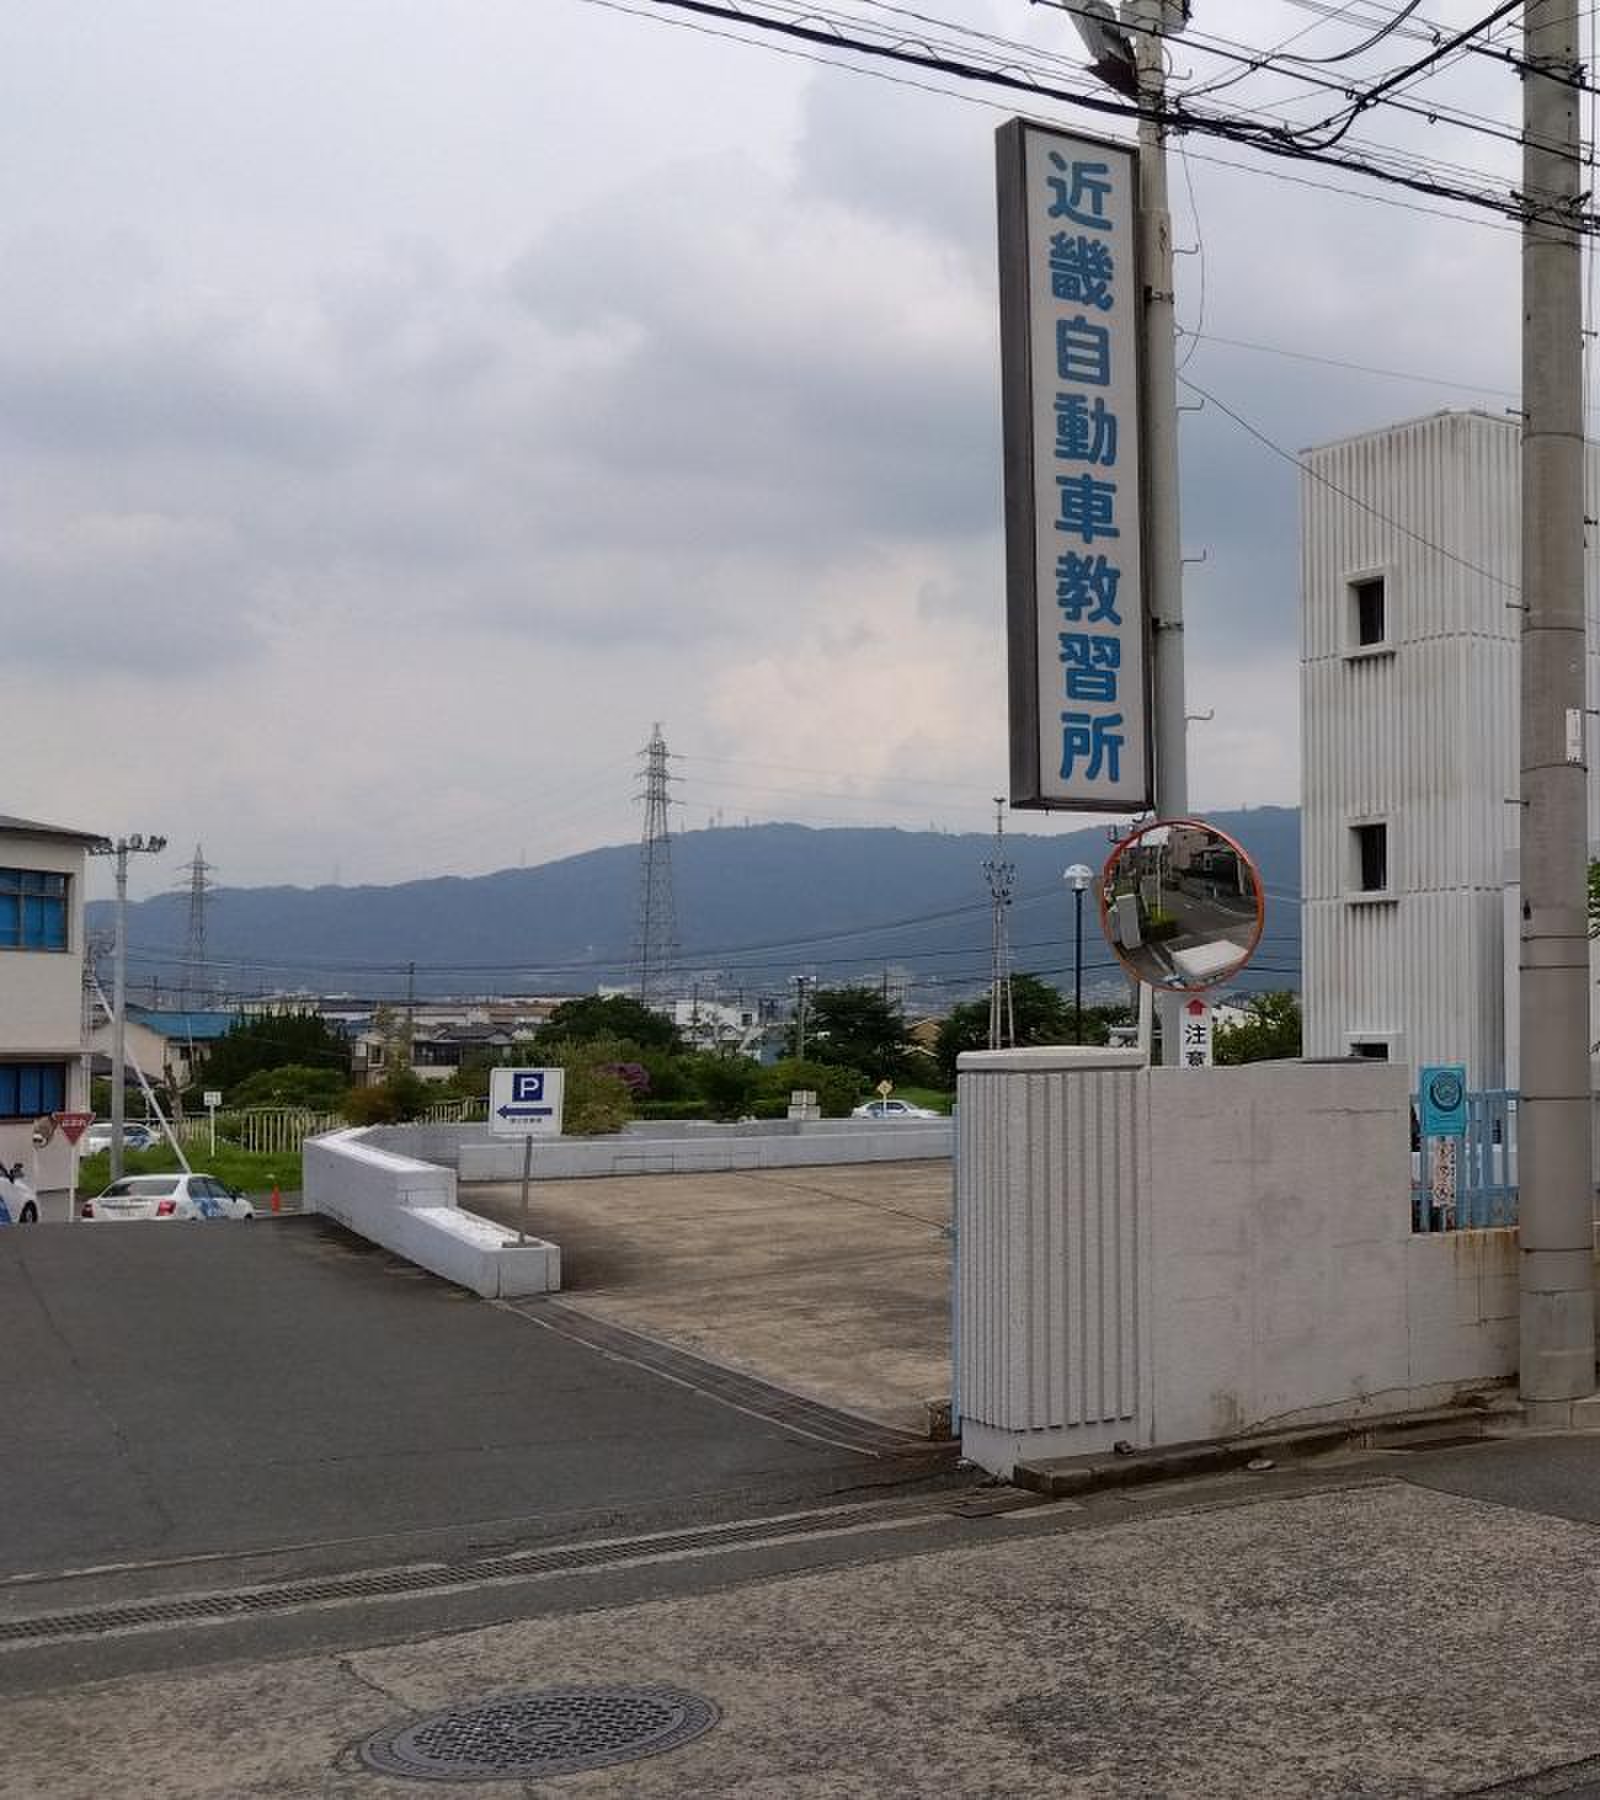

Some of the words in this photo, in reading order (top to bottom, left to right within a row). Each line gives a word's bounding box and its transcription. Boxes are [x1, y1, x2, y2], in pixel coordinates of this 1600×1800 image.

[1046, 150, 1126, 783] 近畿自動車教習所
[520, 1076, 540, 1099] P
